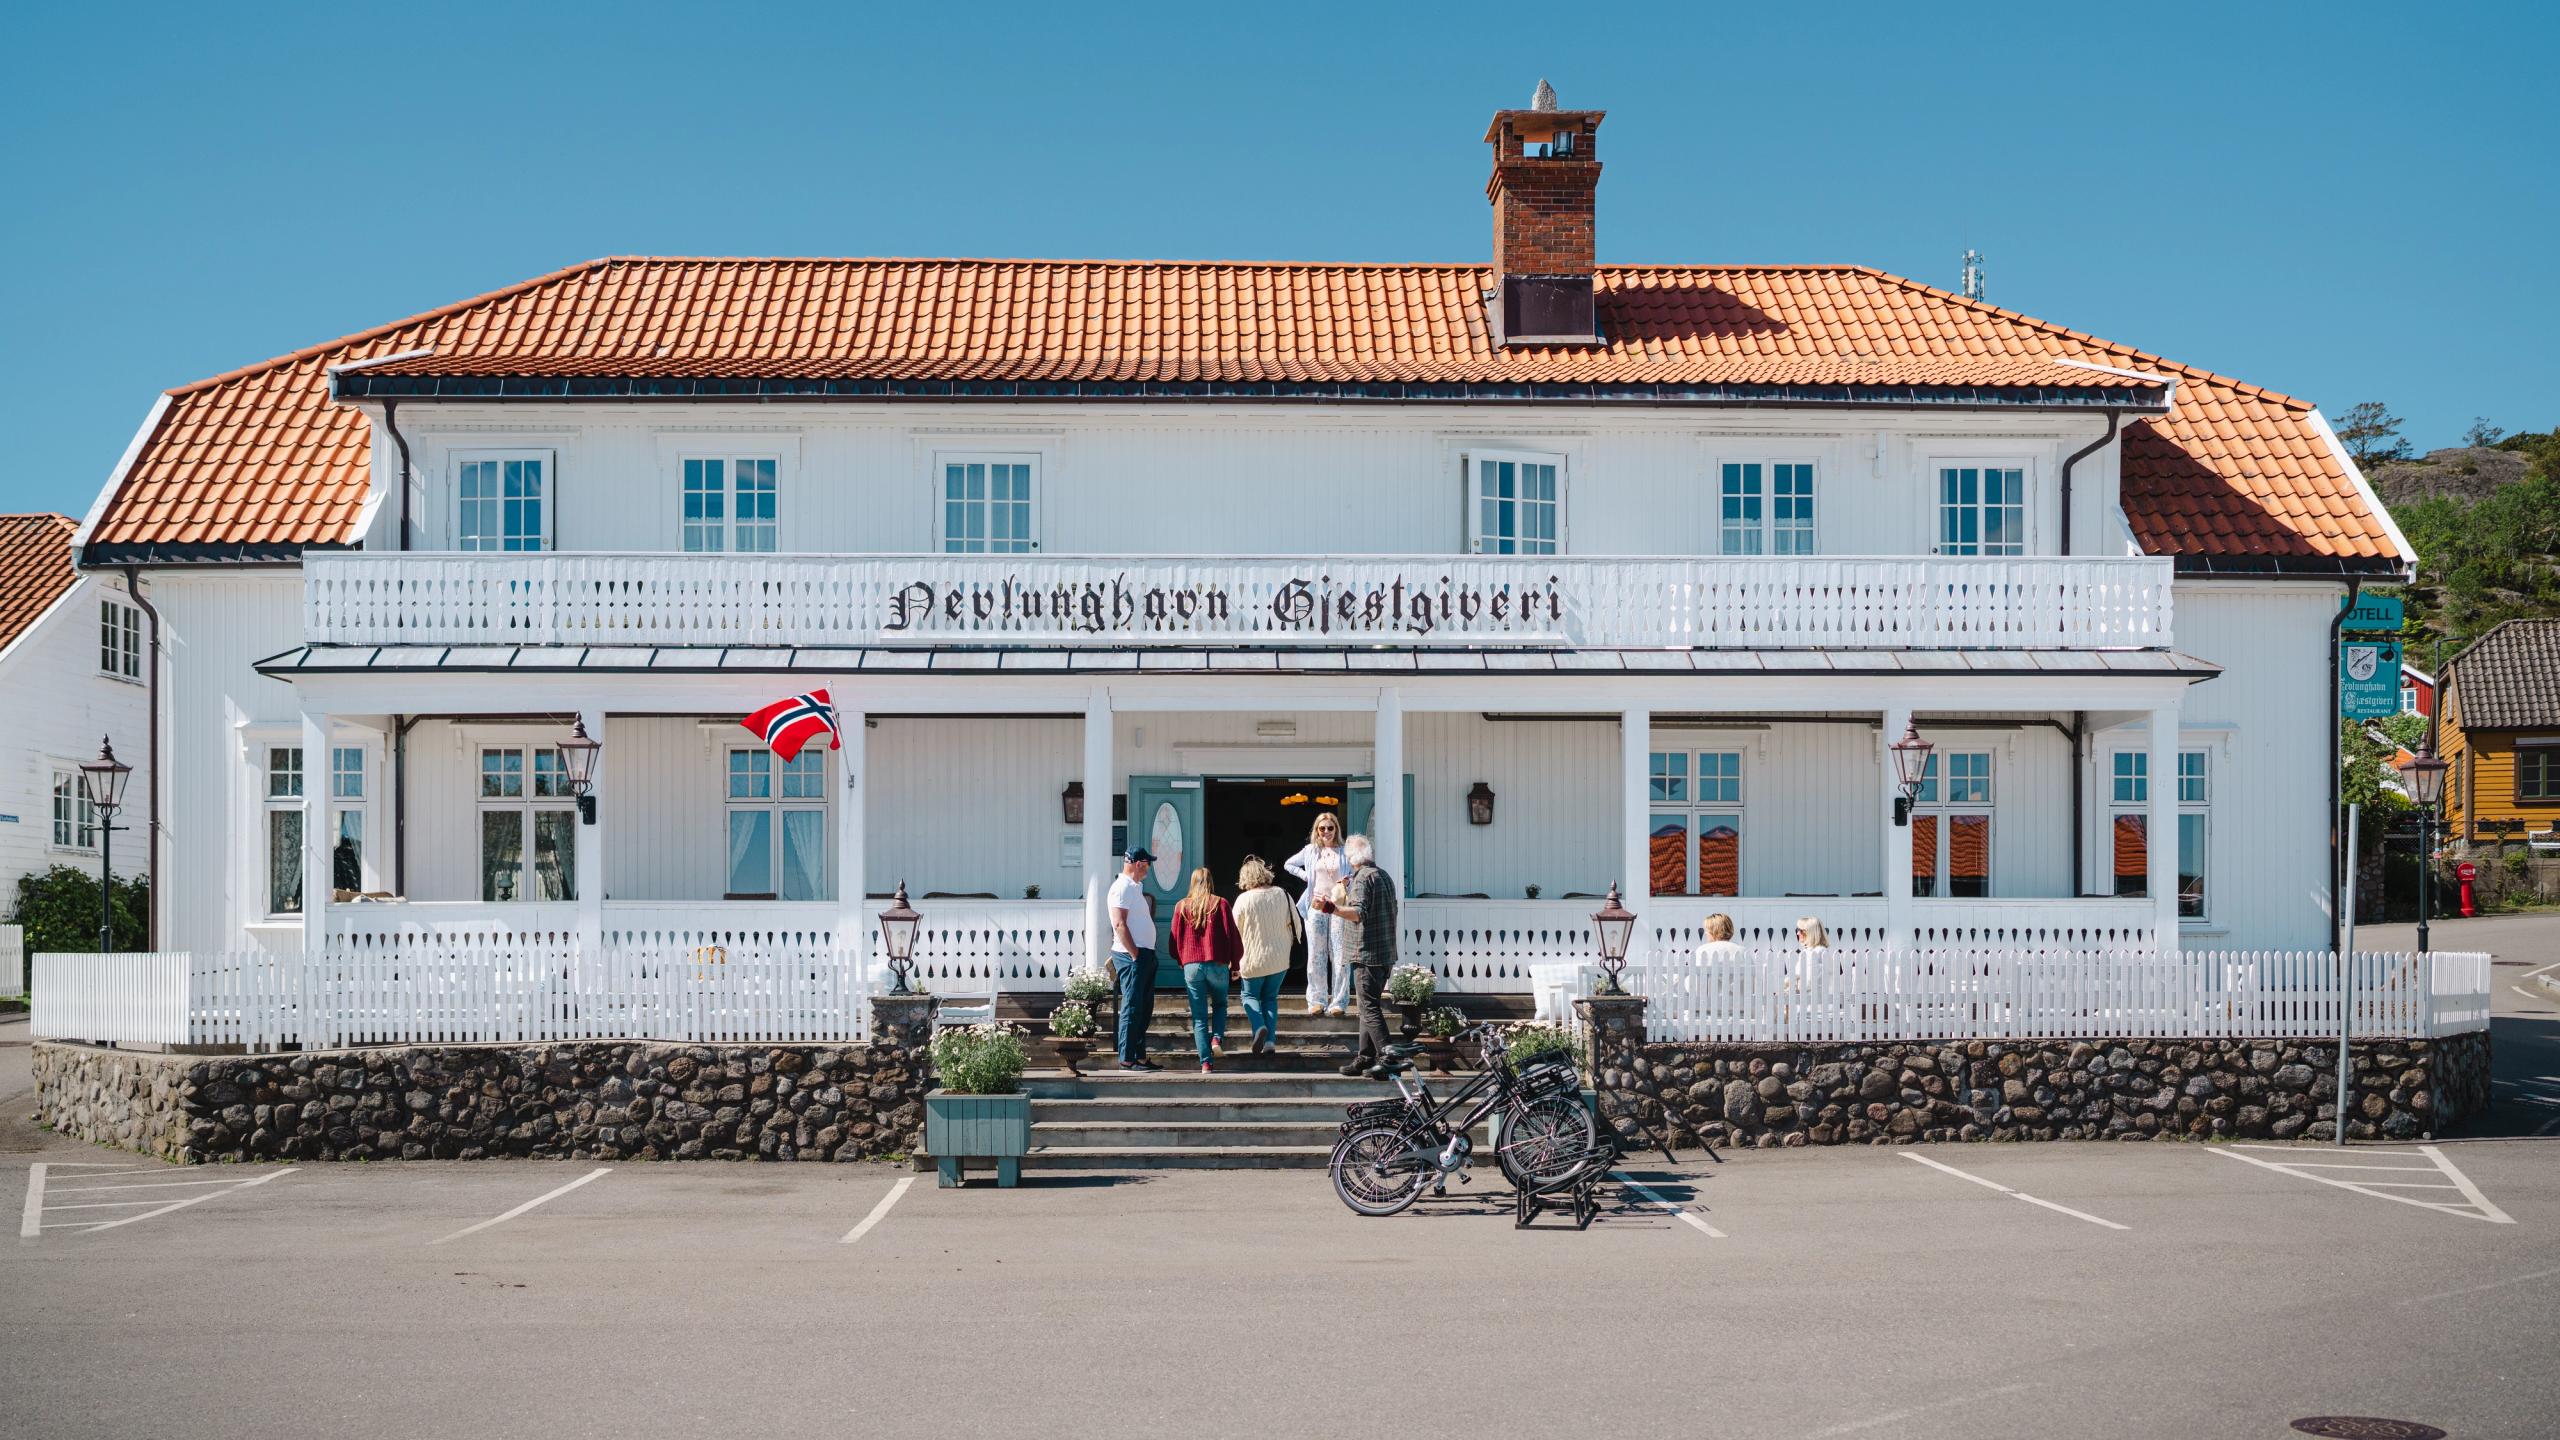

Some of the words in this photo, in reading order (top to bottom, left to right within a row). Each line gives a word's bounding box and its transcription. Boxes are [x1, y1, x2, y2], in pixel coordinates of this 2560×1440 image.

[884, 572, 1229, 634] Nevlunghavn
[1273, 573, 1562, 635] Gjestgiveri
[2346, 607, 2394, 621] OTELL
